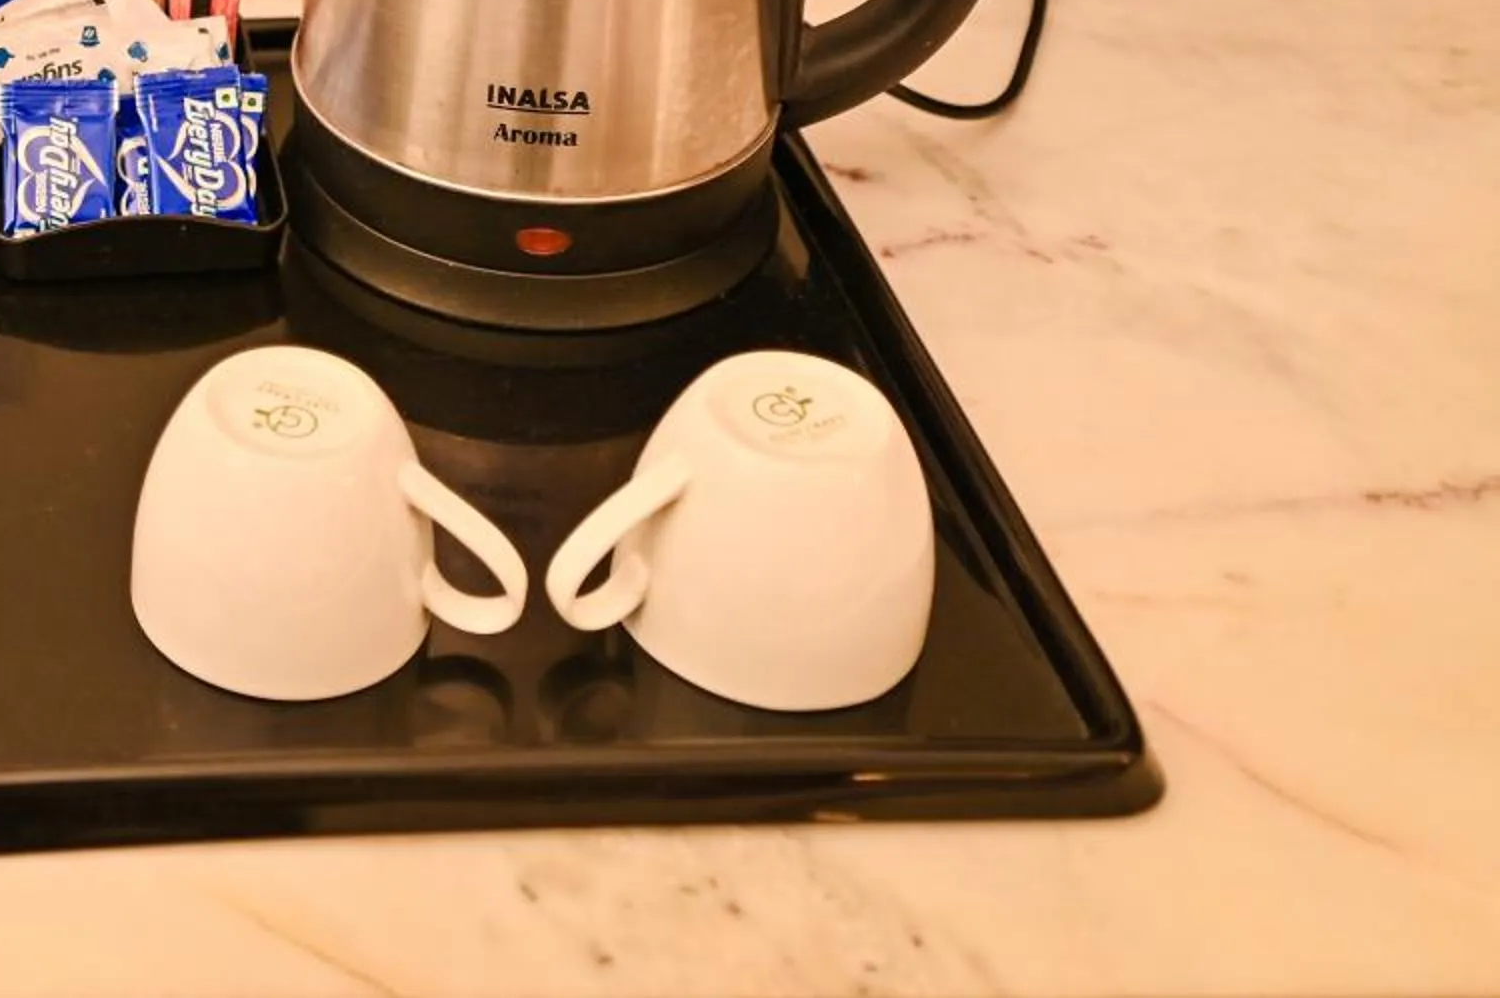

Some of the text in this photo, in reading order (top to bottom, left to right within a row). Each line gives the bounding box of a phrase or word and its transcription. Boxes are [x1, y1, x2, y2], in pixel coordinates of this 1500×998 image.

[486, 83, 591, 111] INALSA
[494, 123, 579, 147] Aroma
[38, 115, 79, 230] veryDay
